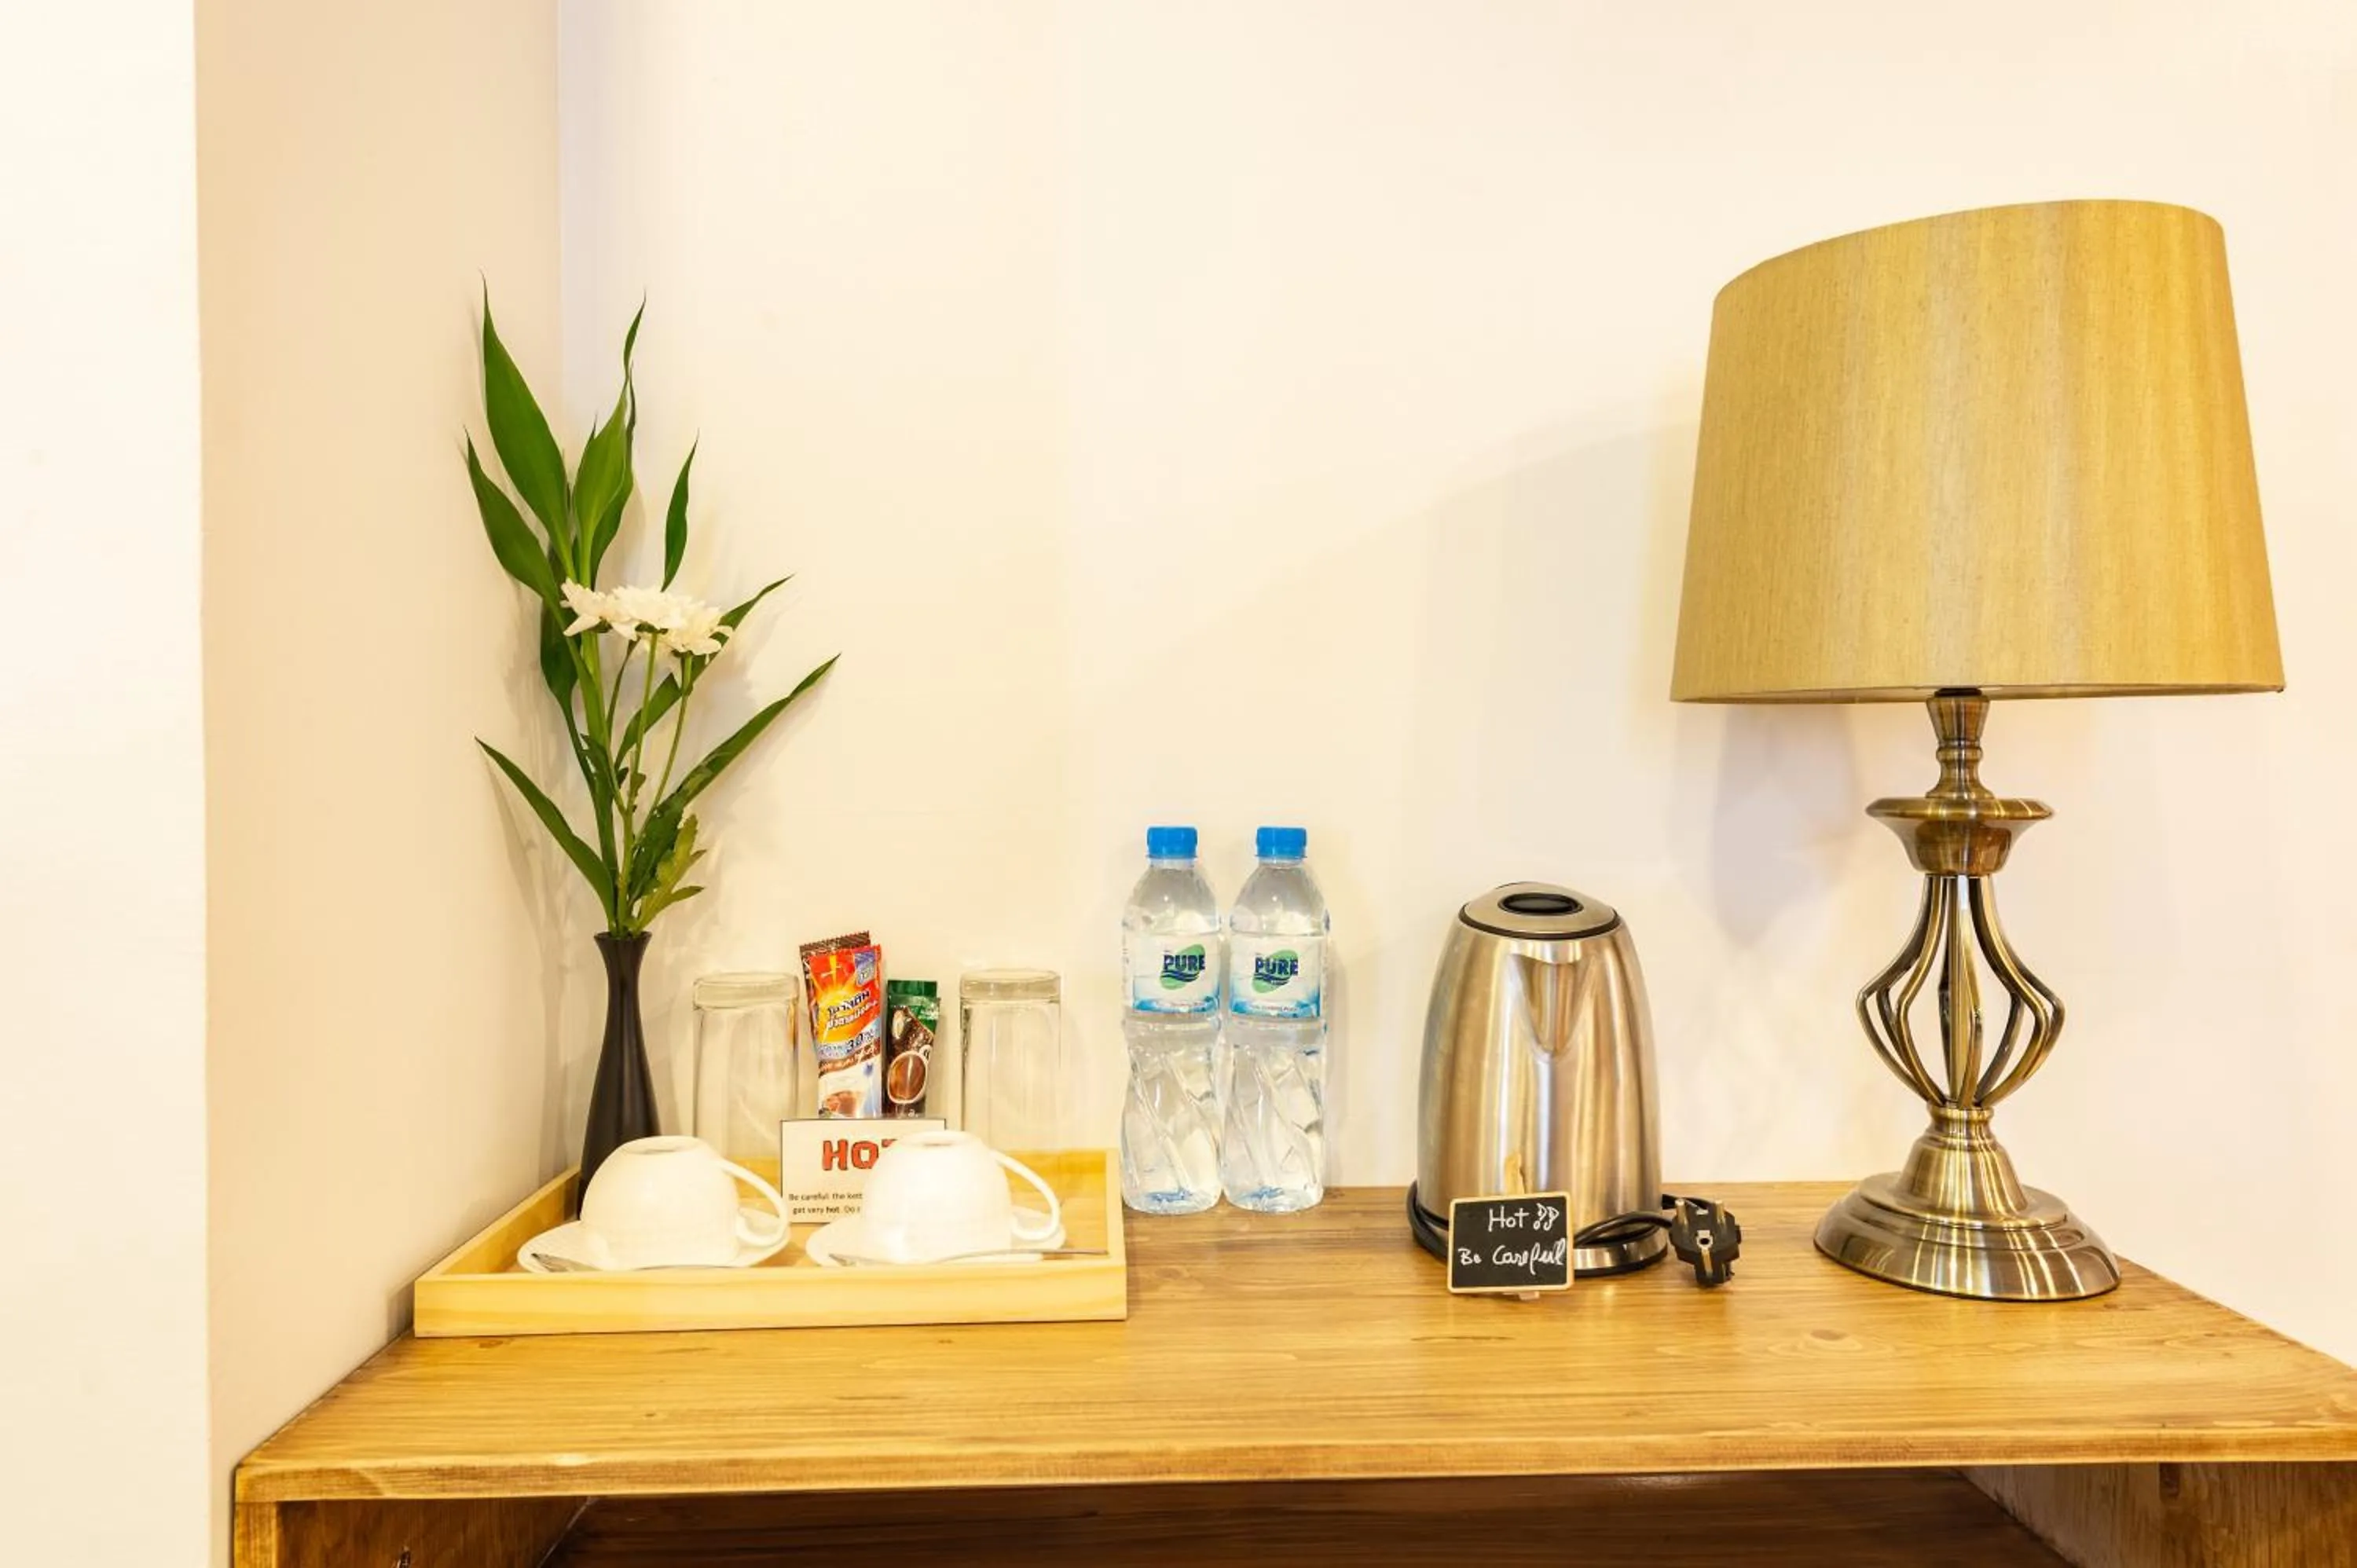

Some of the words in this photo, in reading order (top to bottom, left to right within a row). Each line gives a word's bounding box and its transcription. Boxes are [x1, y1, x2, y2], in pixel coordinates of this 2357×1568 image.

[1164, 954, 1206, 971] PURE
[1255, 957, 1299, 976] PURE
[793, 1207, 805, 1215] get
[807, 1207, 824, 1215] very
[1487, 1204, 1530, 1233] Hot
[1457, 1247, 1483, 1266] Be
